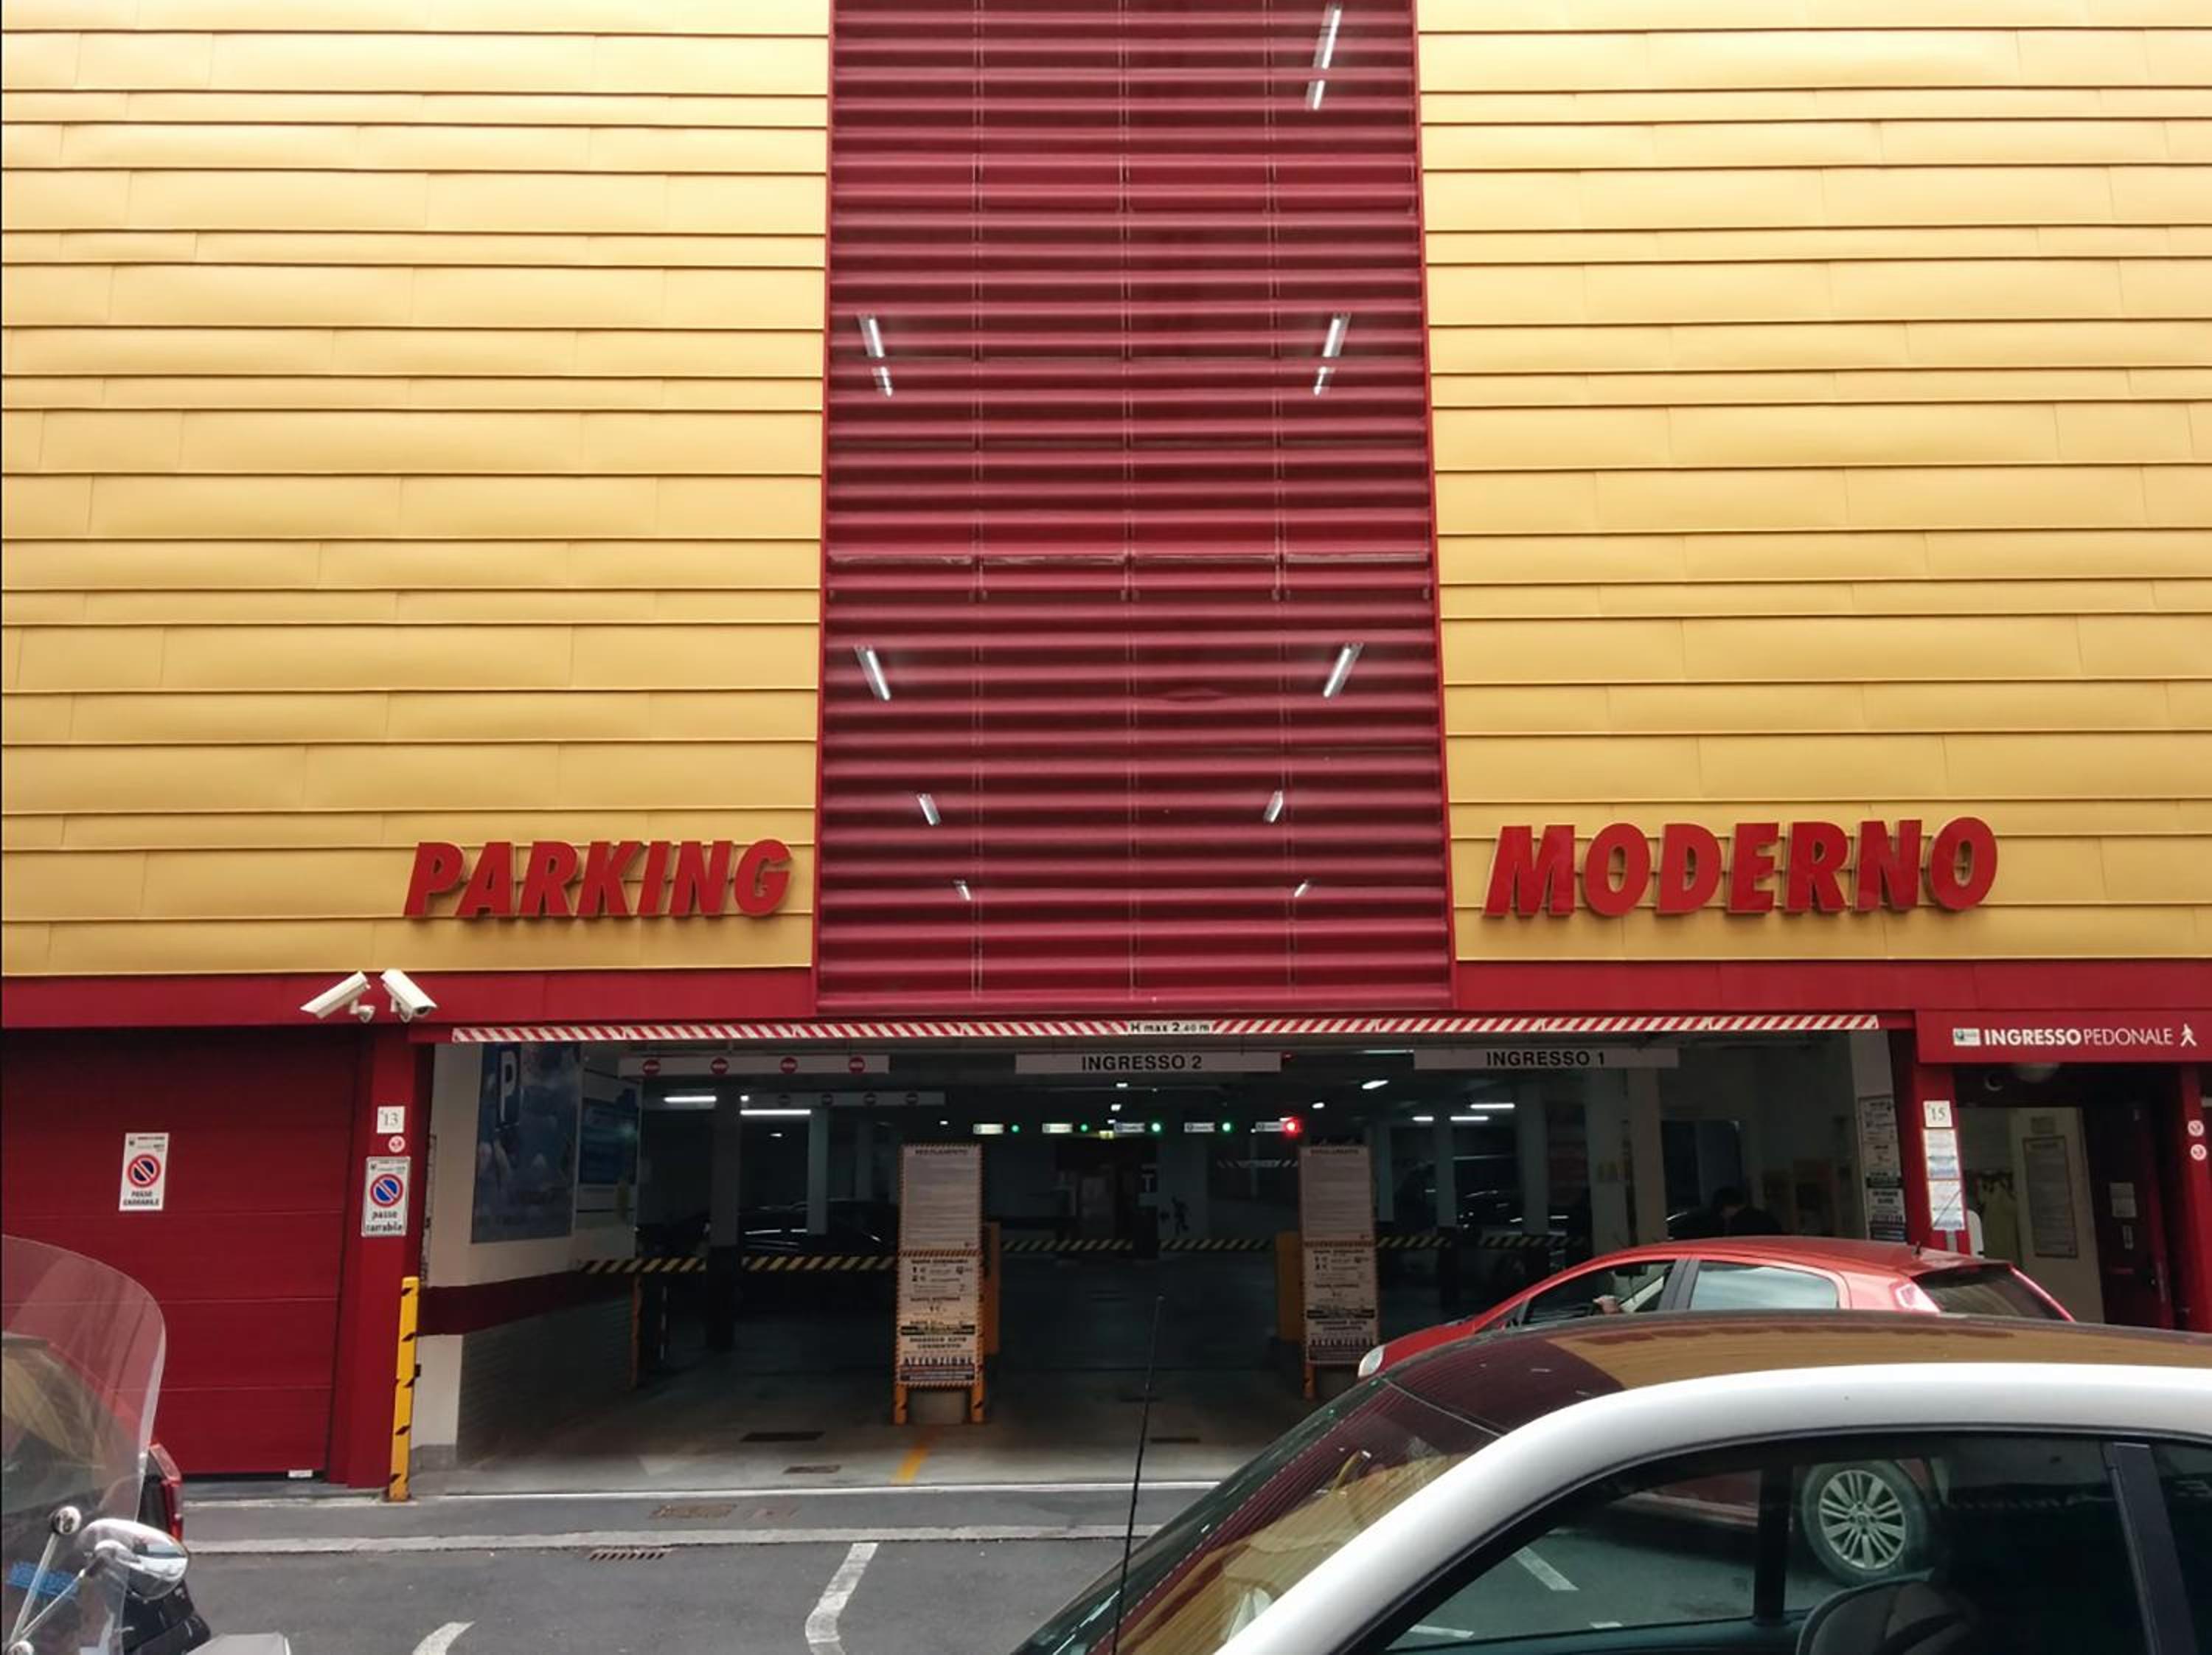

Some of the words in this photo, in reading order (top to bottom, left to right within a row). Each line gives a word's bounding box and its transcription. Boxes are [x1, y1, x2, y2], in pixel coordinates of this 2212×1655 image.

[1481, 816, 1999, 917] MODERNO
[403, 838, 793, 919] PARKING
[1130, 1023, 1141, 1032] H
[1081, 1054, 1186, 1070] INGRESSO
[1191, 1055, 1203, 1069] 2
[1486, 1051, 1590, 1066] INGRESSO
[1598, 1052, 1605, 1066] 1
[383, 1112, 399, 1127] 13
[1930, 1107, 1946, 1121] 15
